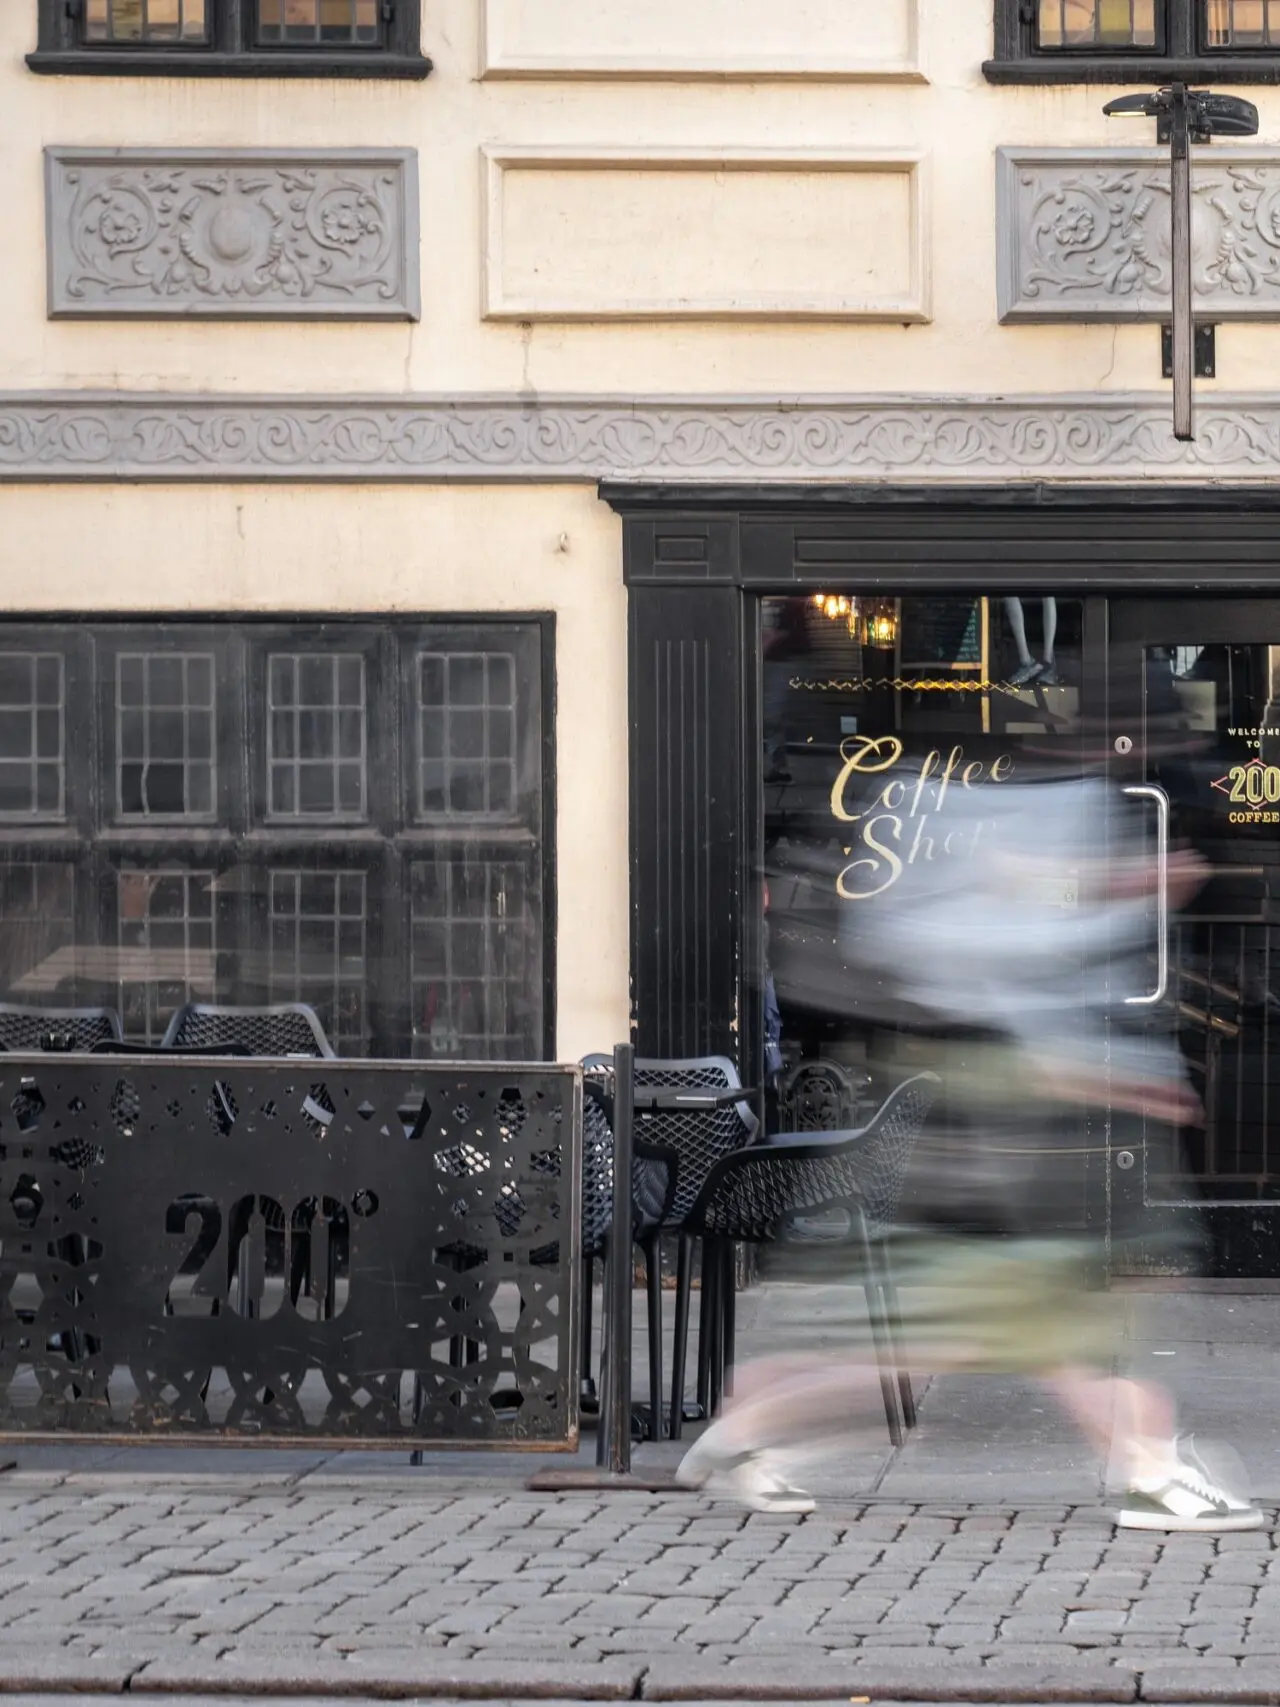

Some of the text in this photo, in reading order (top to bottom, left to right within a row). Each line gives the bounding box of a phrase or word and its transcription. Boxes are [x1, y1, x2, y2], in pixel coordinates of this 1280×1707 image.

[1227, 727, 1280, 736] WELCOME
[1246, 740, 1261, 748] TO
[830, 735, 1016, 822] Coffee
[1228, 812, 1280, 823] COFFEE
